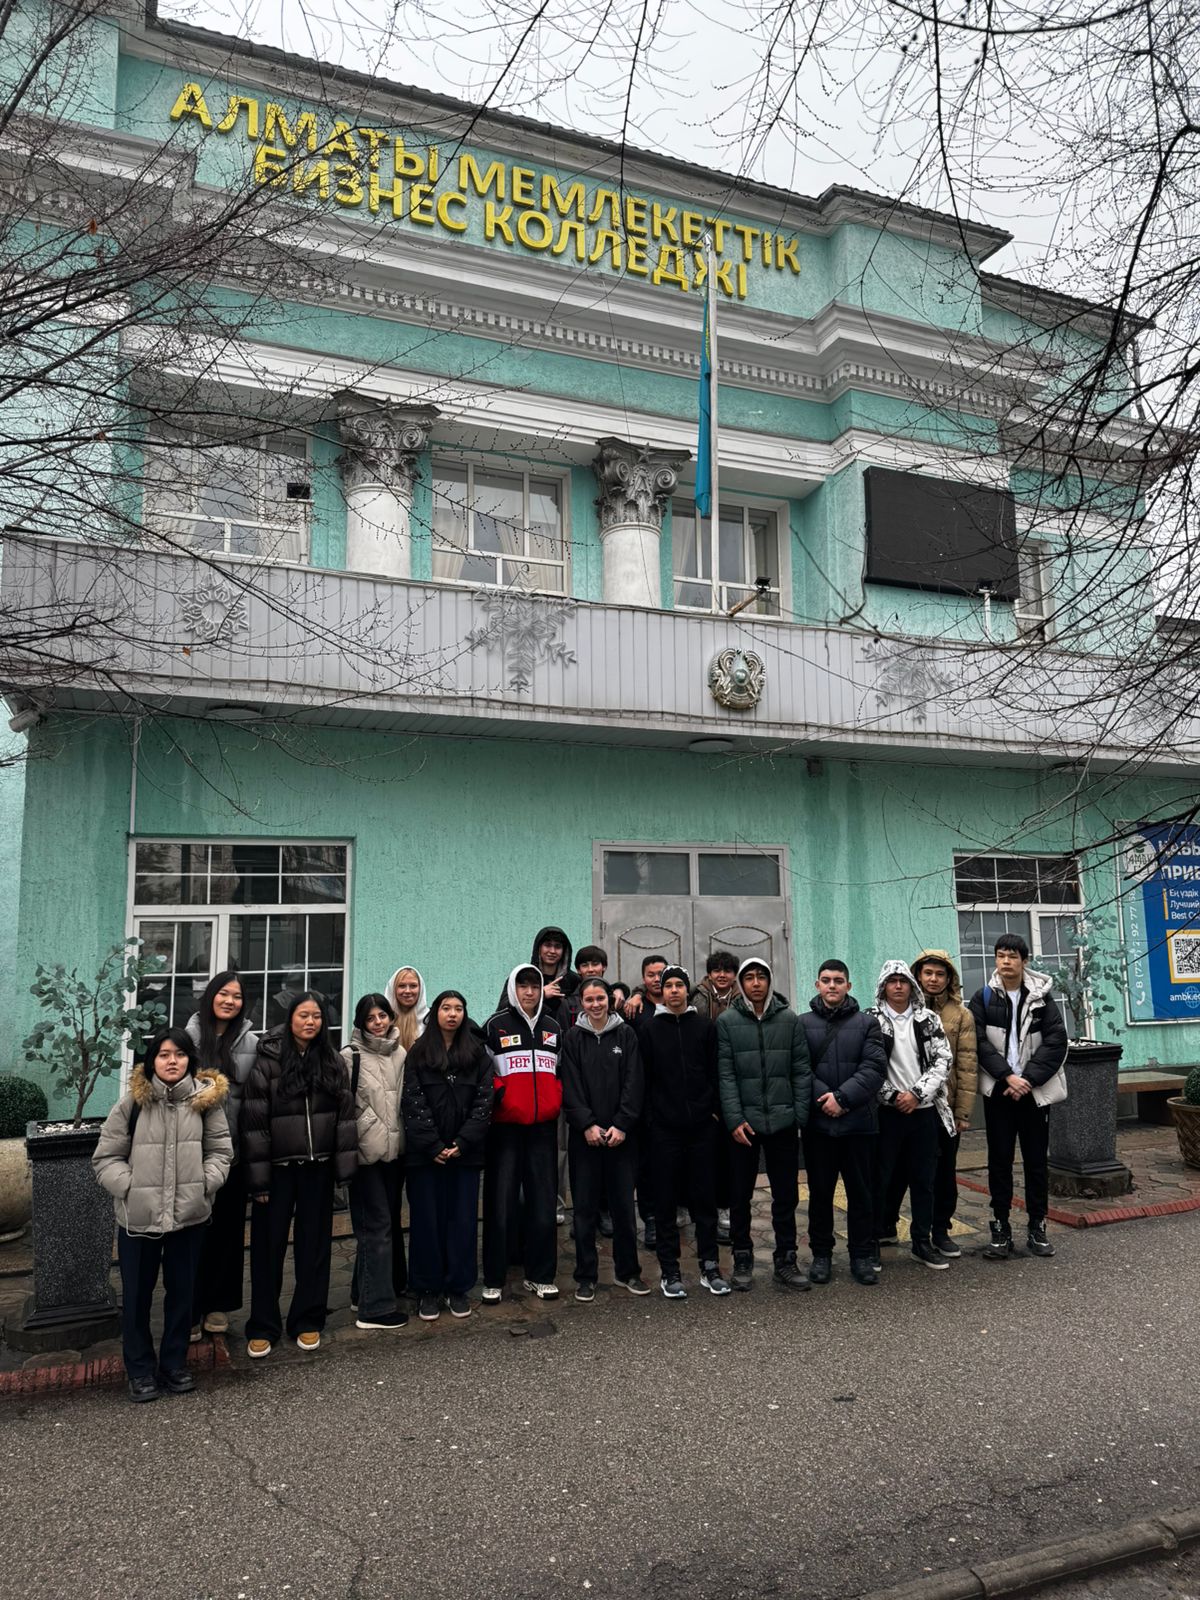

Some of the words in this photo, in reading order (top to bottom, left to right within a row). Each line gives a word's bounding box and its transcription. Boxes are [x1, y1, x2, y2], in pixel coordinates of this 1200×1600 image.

[170, 82, 439, 183] АЛМАТЫ
[458, 153, 801, 274] МЕМЛЕКЕТТІК
[254, 145, 469, 233] БИЗНЕС
[484, 200, 748, 299] КОЛЛЕДЖІ
[1129, 906, 1137, 921] 77
[1171, 911, 1187, 920] Best
[1130, 922, 1139, 937] 92
